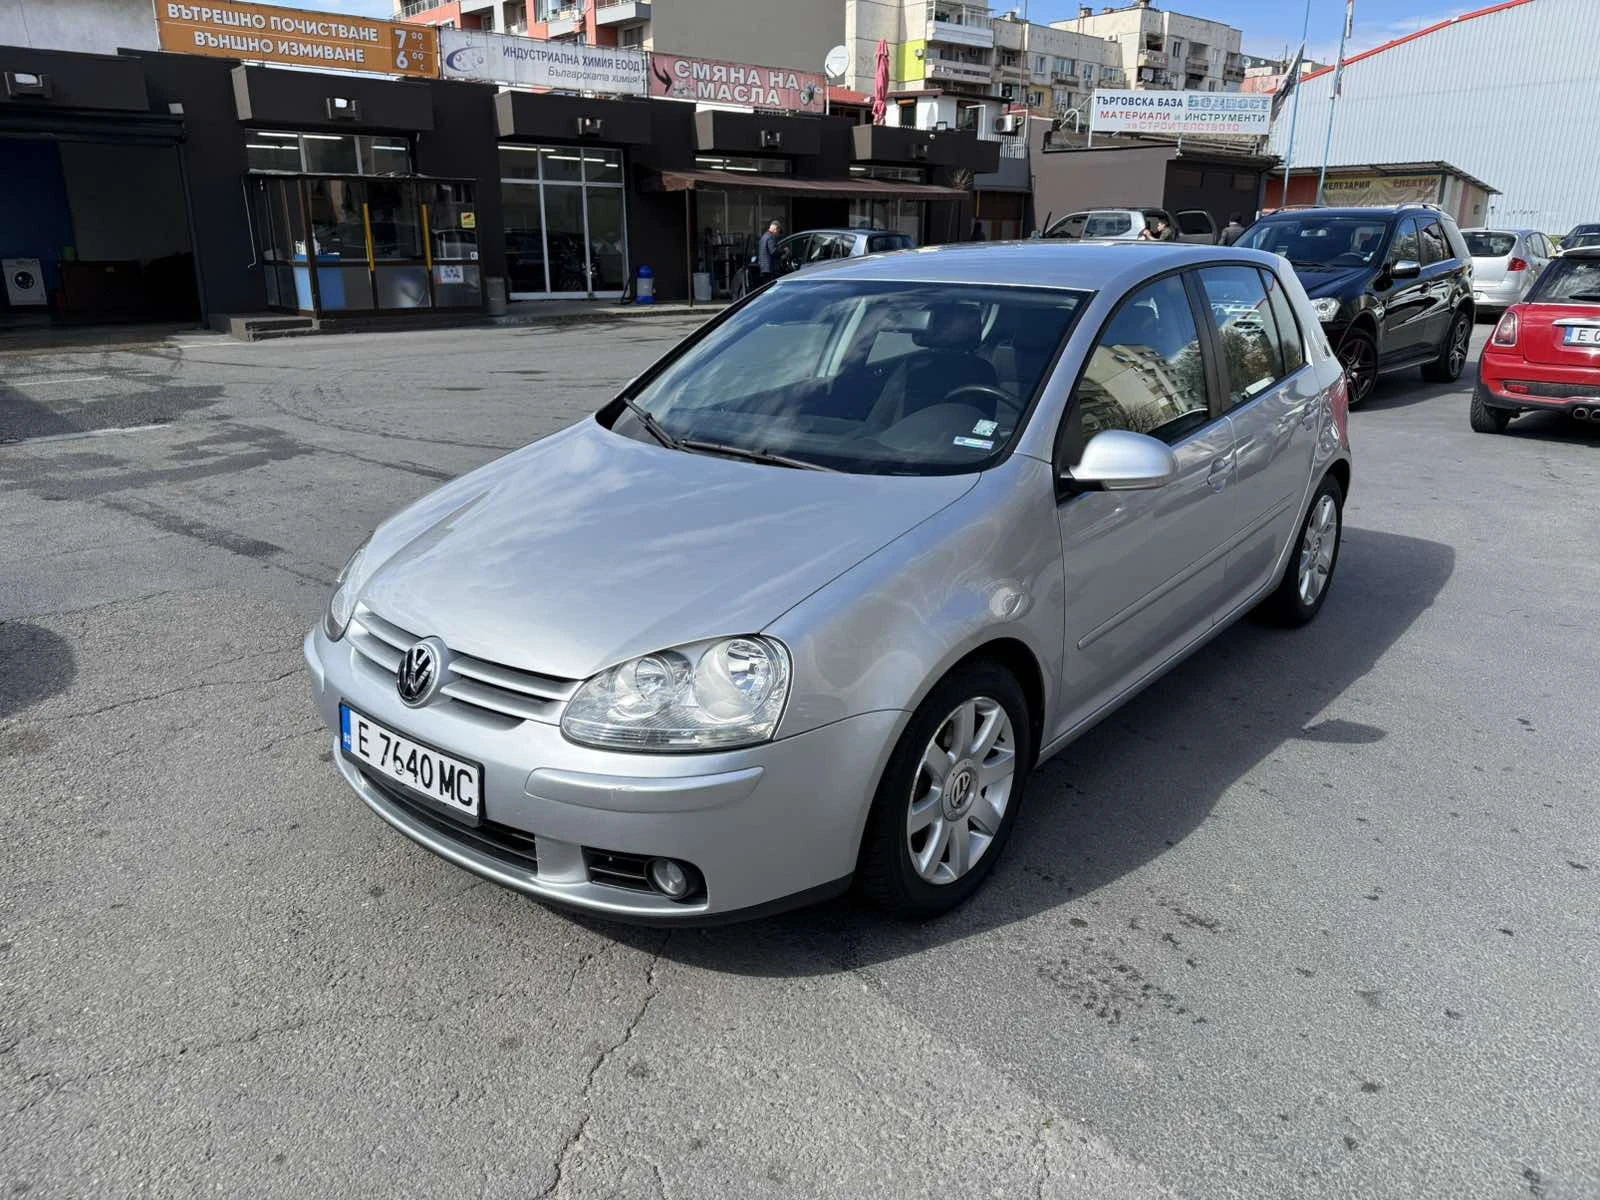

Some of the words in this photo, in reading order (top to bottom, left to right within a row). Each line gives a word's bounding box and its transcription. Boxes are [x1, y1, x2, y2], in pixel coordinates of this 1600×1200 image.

[167, 3, 266, 29] ВЪТРЕШНО
[270, 16, 379, 42] ПОЧИСТВАНЕ
[193, 31, 274, 54] ВЪНШНО
[278, 40, 365, 63] ИЗМИВАНЕ
[394, 29, 407, 49] 7
[395, 51, 409, 69] 6
[502, 46, 580, 66] ИНДУСТРИАЛНА
[581, 56, 614, 69] ХИМИЯ
[615, 60, 640, 72] ЕООД
[548, 66, 610, 82] Българската
[673, 60, 762, 86] СМЯНА
[768, 71, 799, 91] НА
[697, 82, 781, 105] МАСЛА
[1096, 96, 1155, 106] ТЪРГОВСКА
[1157, 98, 1183, 107] БАЗА
[1100, 111, 1171, 120] МАТЕРИАЛИ
[1184, 112, 1266, 122] ИНСТРУМЕНТИ
[358, 720, 370, 758] E
[379, 732, 434, 789] 7640
[439, 759, 474, 807] MC
